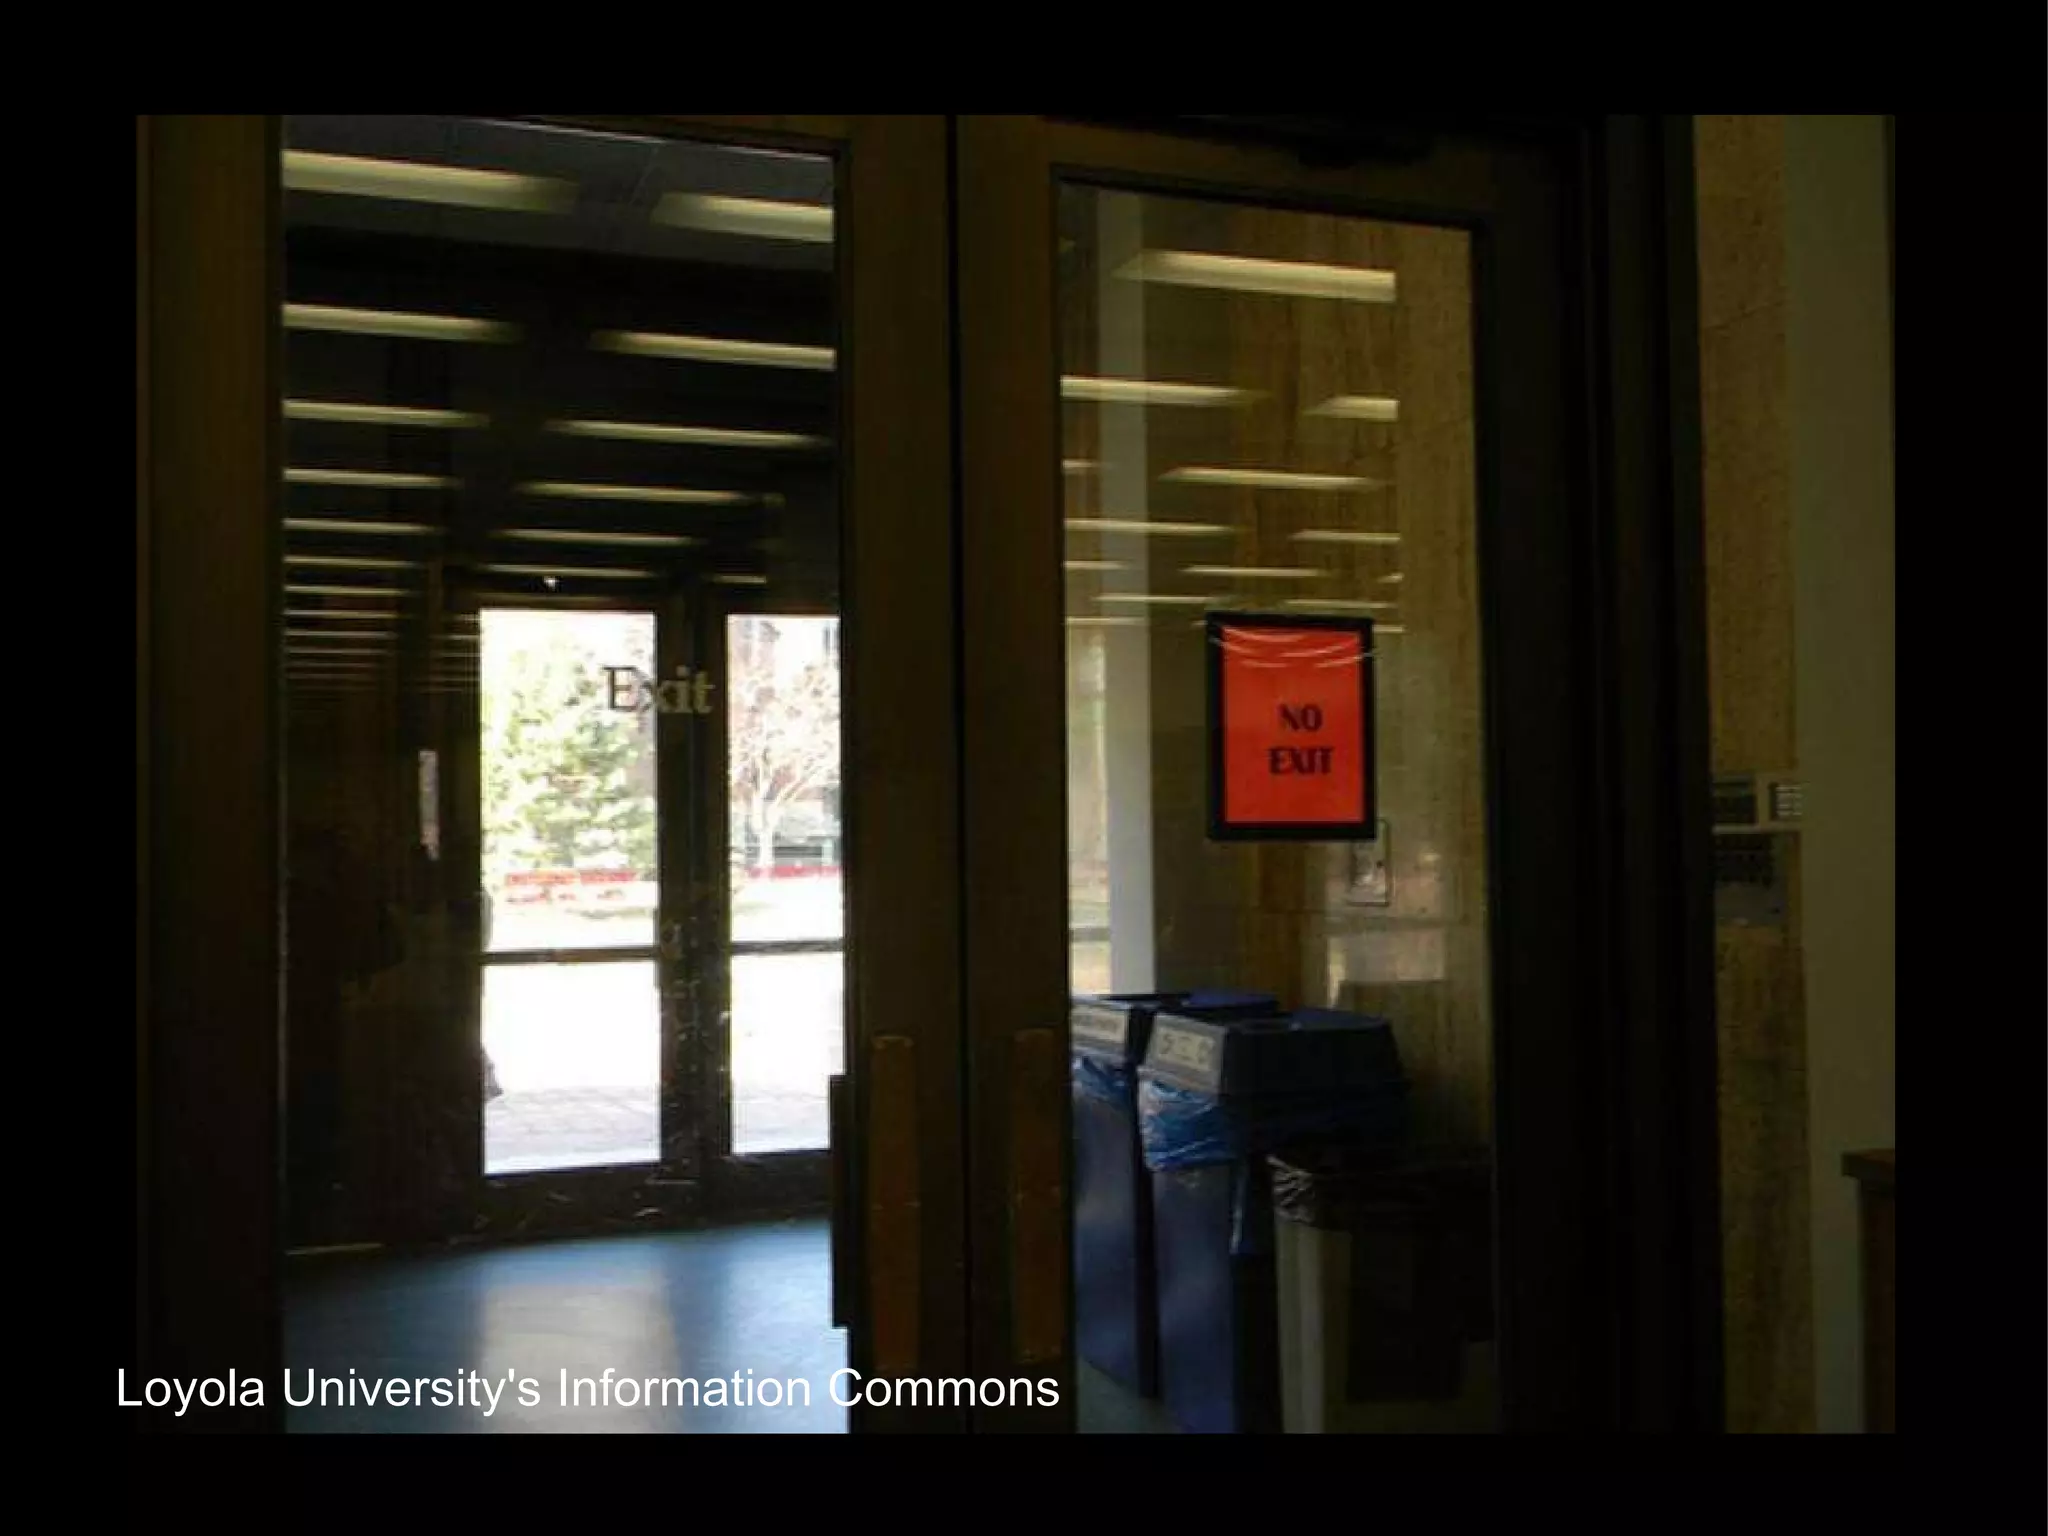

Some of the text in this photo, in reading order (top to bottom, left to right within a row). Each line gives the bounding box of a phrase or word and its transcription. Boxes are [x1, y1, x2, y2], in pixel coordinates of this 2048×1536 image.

[602, 664, 716, 714] Exit
[1279, 703, 1323, 732] NO
[1269, 746, 1335, 775] EXIT
